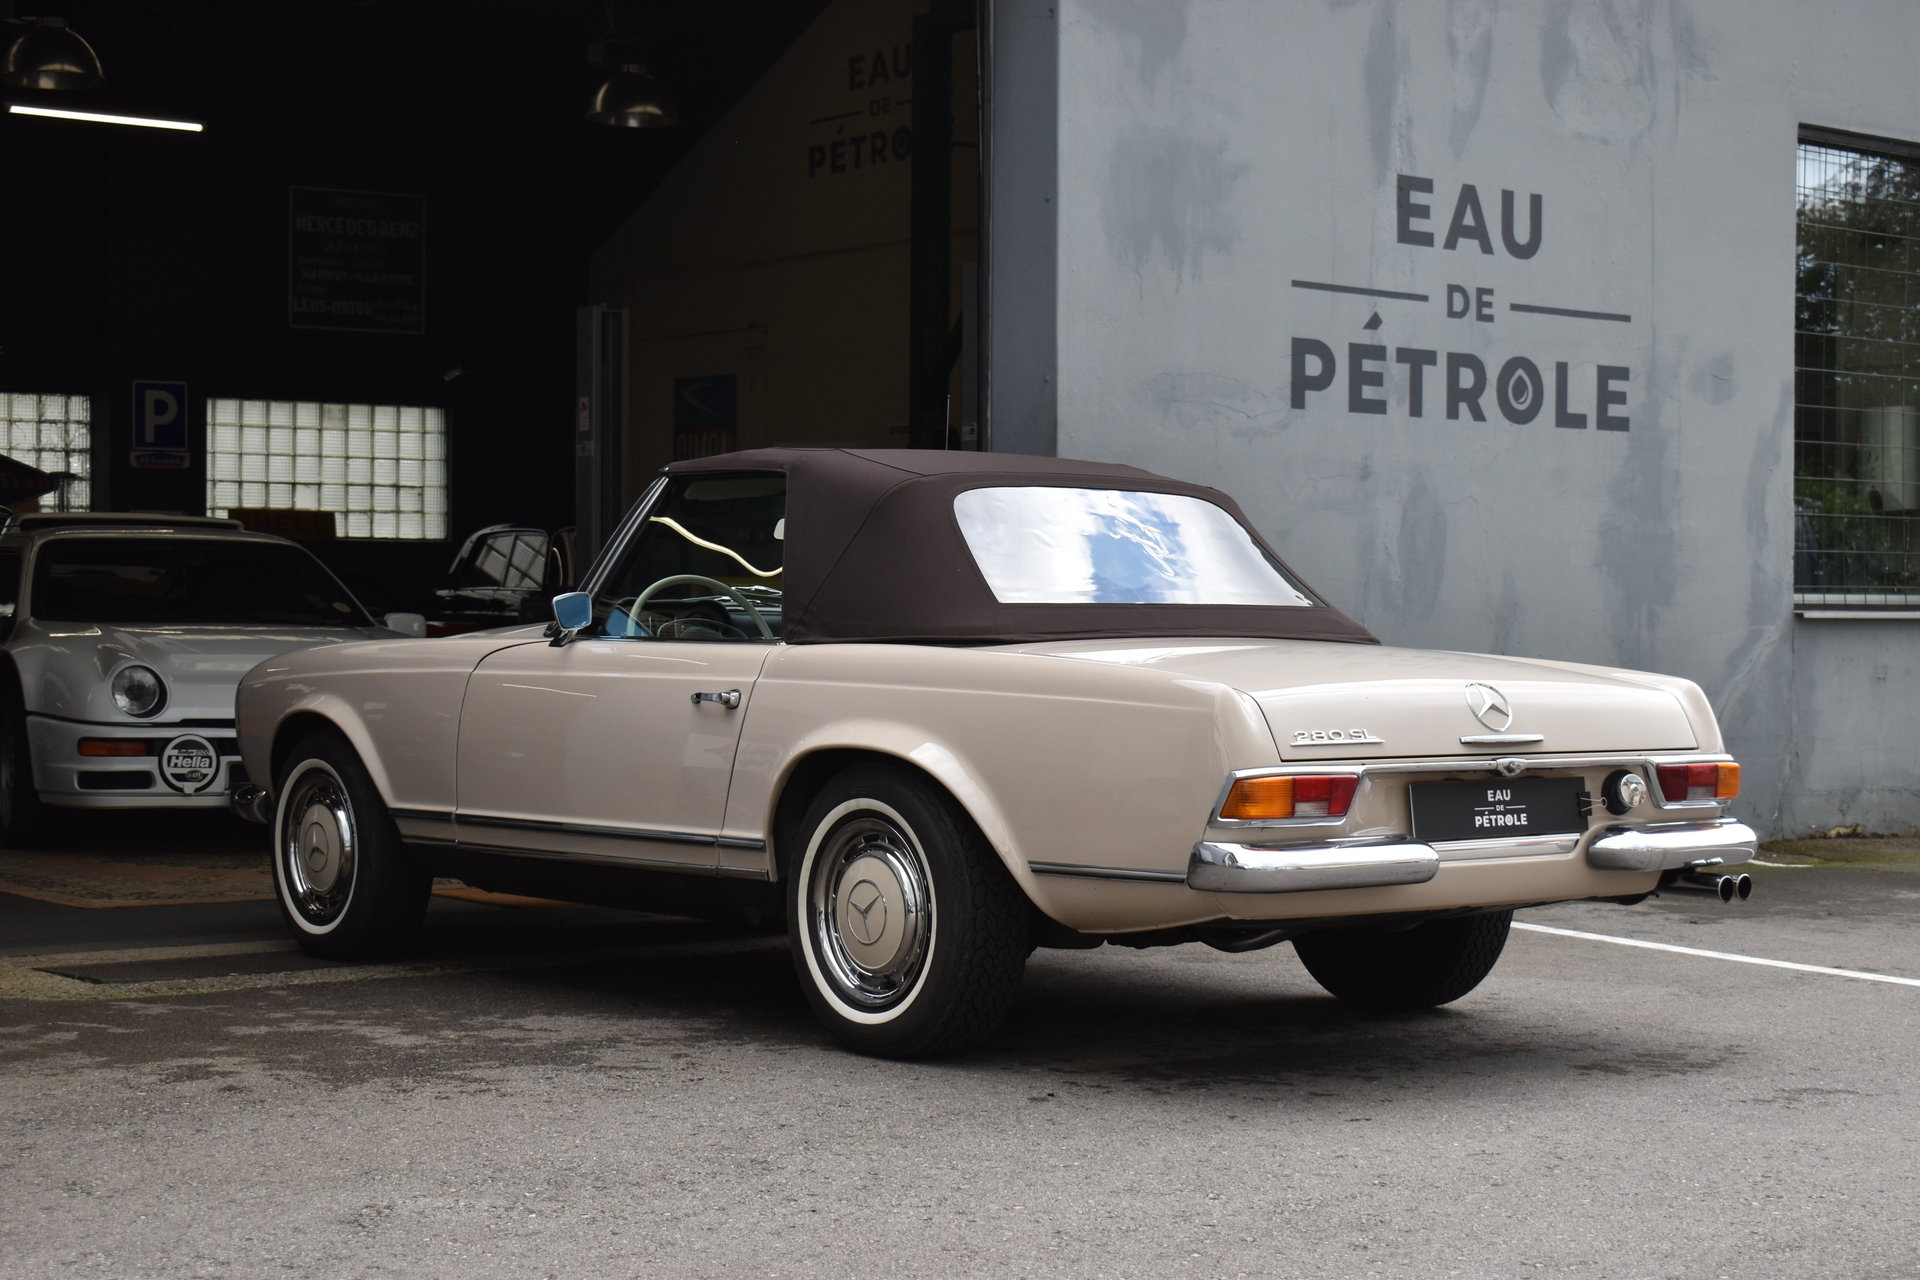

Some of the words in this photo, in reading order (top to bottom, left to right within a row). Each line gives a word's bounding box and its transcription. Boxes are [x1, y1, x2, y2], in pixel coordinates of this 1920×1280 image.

[849, 43, 912, 90] EAU
[870, 97, 891, 116] DE
[809, 124, 912, 177] PÉTRO
[1396, 173, 1543, 260] EAU
[1446, 283, 1495, 323] DE
[1290, 311, 1631, 432] PÉTROLE
[144, 389, 178, 443] P
[1293, 729, 1345, 742] 280
[1349, 728, 1378, 740] SL
[170, 756, 210, 767] Hella
[1487, 789, 1511, 802] EAU
[1474, 811, 1528, 828] PÉTROLE
